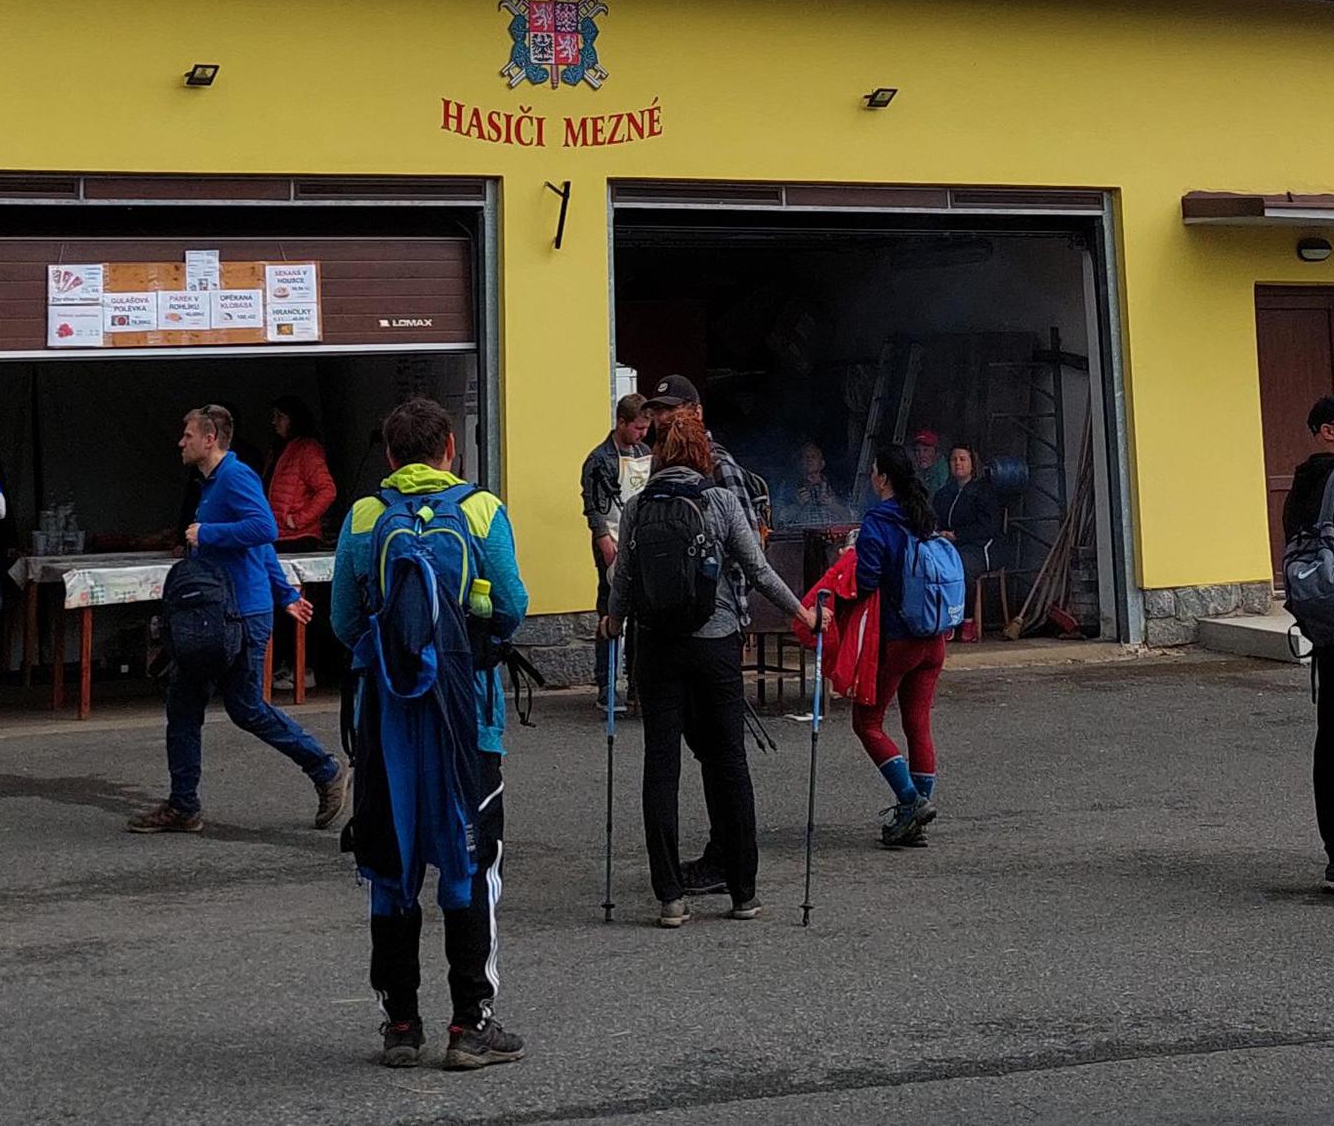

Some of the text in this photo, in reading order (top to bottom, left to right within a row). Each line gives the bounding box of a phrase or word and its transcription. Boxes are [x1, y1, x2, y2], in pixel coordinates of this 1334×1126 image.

[441, 97, 663, 148] HASIČI MEZNÉ
[392, 318, 432, 327] LOMAX
